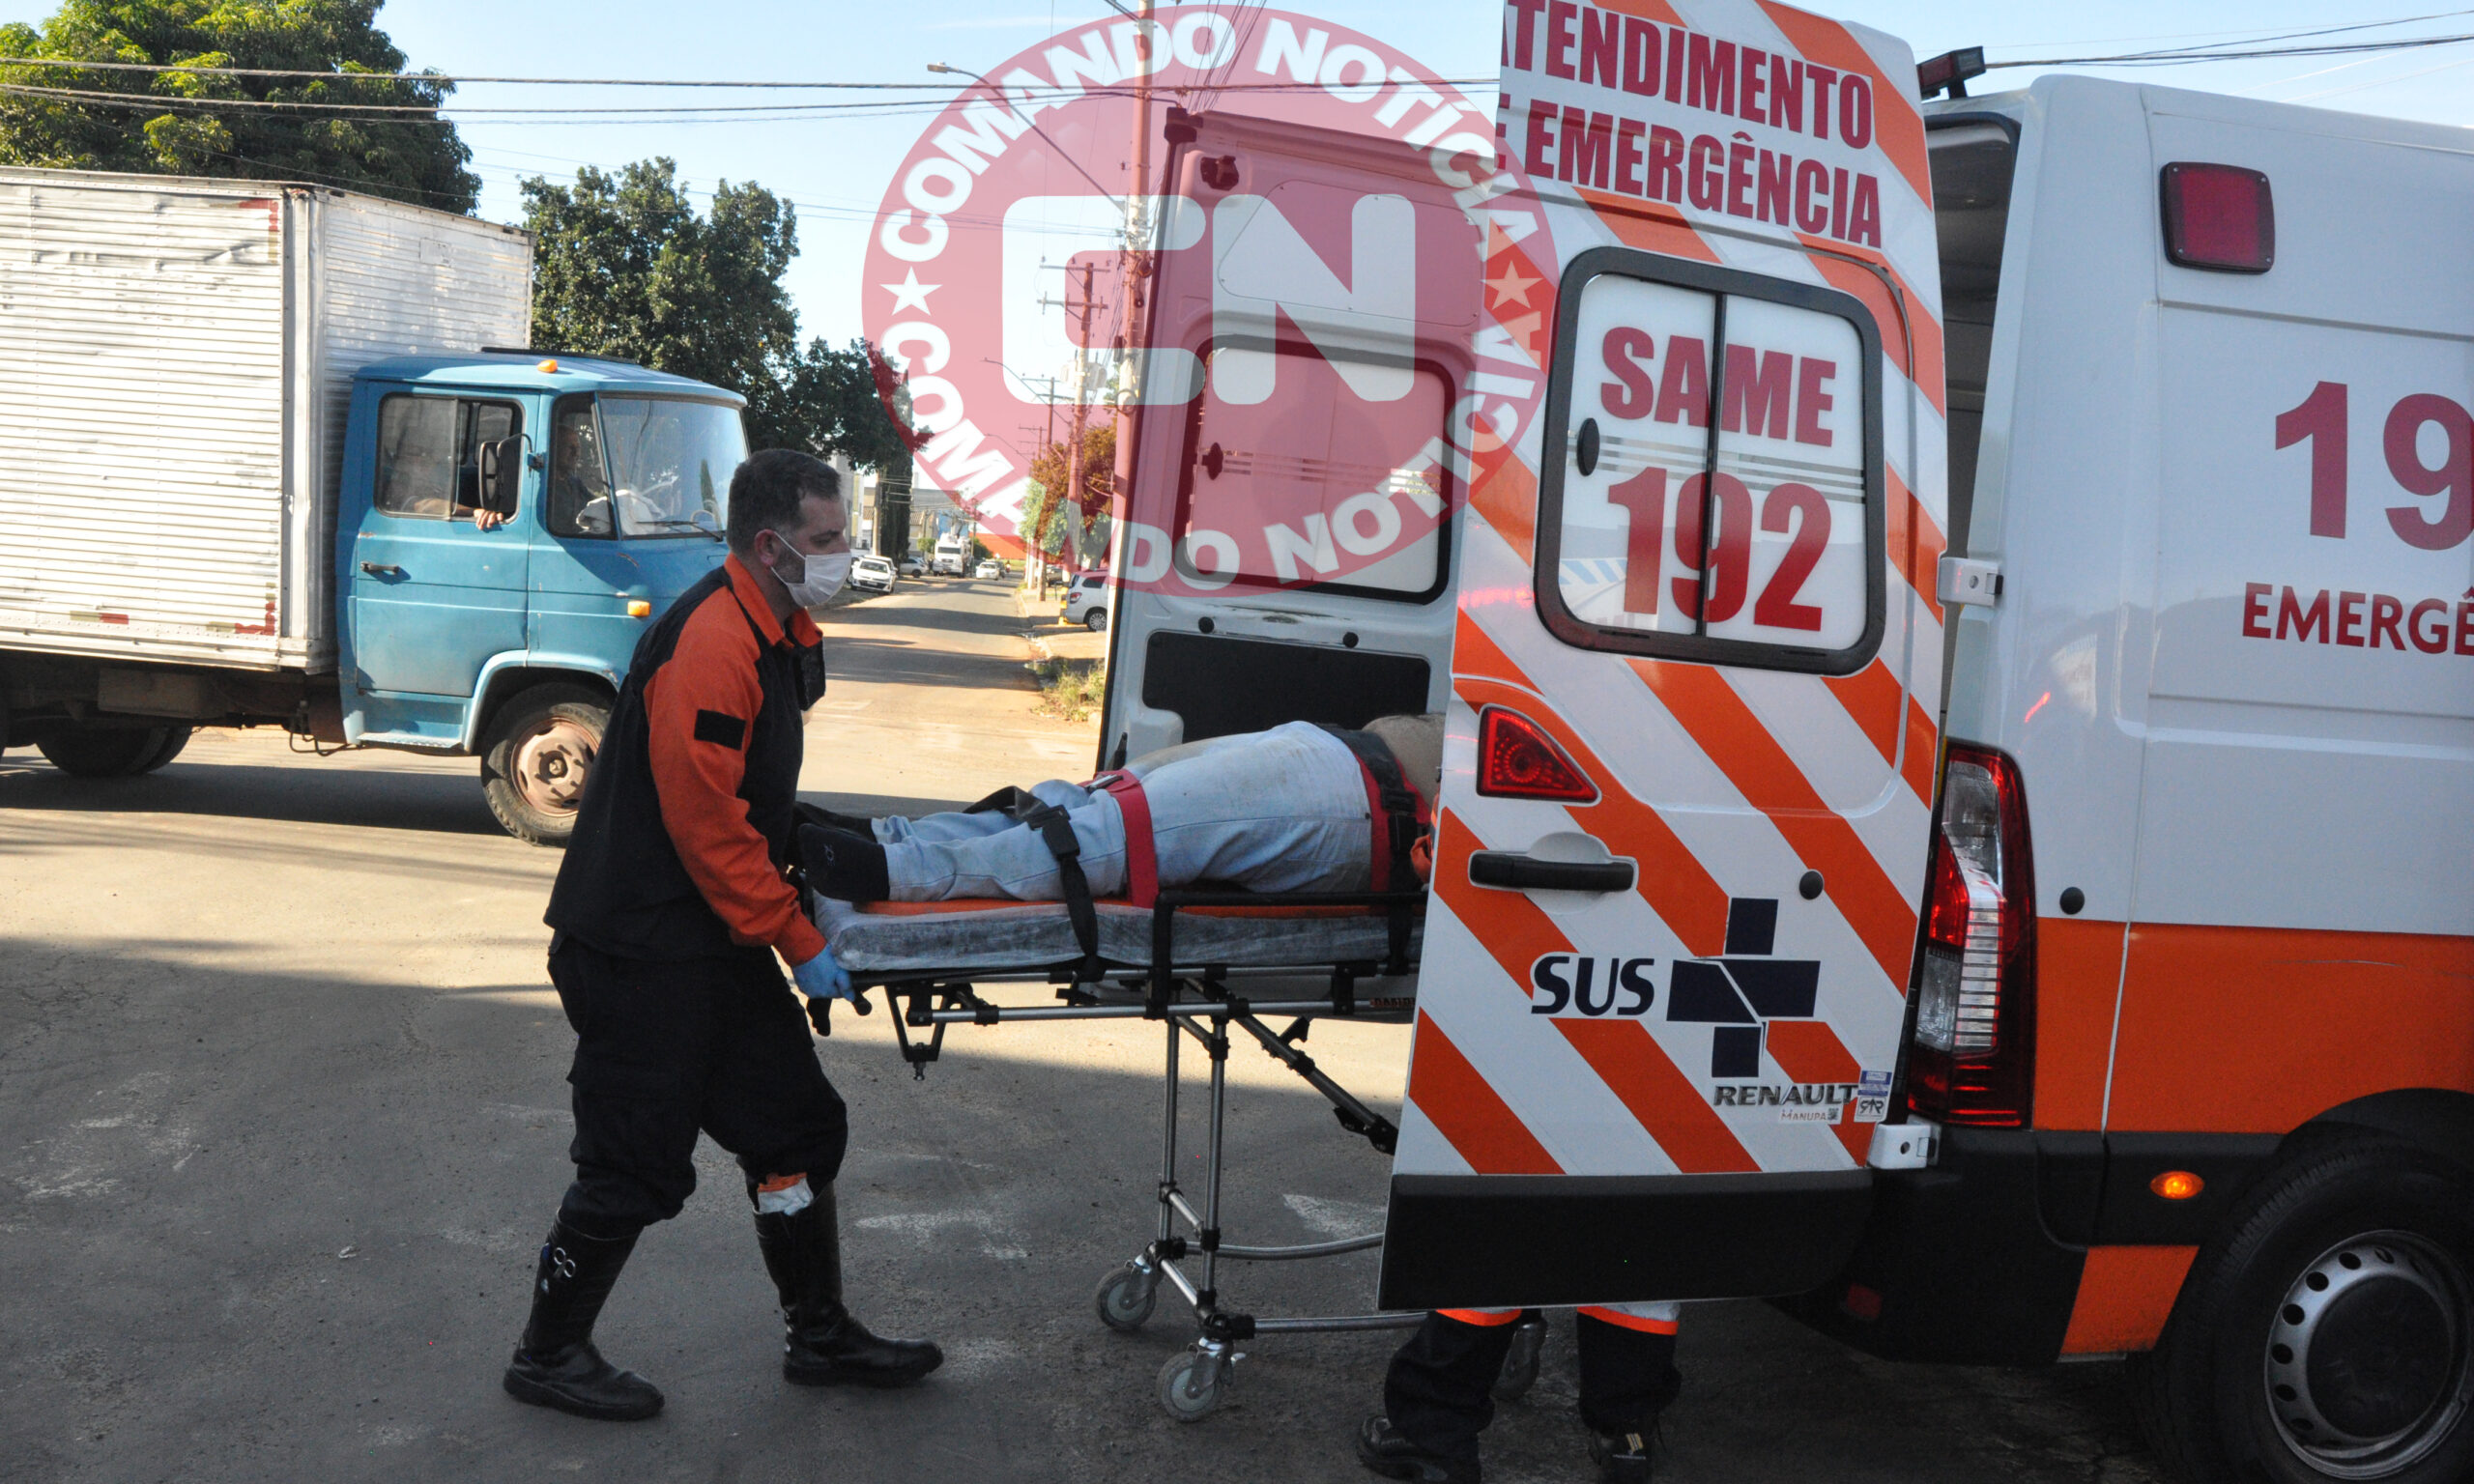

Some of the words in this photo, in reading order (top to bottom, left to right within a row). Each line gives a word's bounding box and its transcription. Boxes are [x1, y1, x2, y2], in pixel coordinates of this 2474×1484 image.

[1501, 0, 1873, 150] TENDIMENTO
[1524, 99, 1883, 248] EMERGÊNCIA
[1600, 326, 1836, 447] SAME
[2275, 381, 2474, 551] 19
[1607, 467, 1832, 632] 192
[1531, 956, 1655, 1016] SUS
[1712, 1084, 1859, 1106] RENAULT
